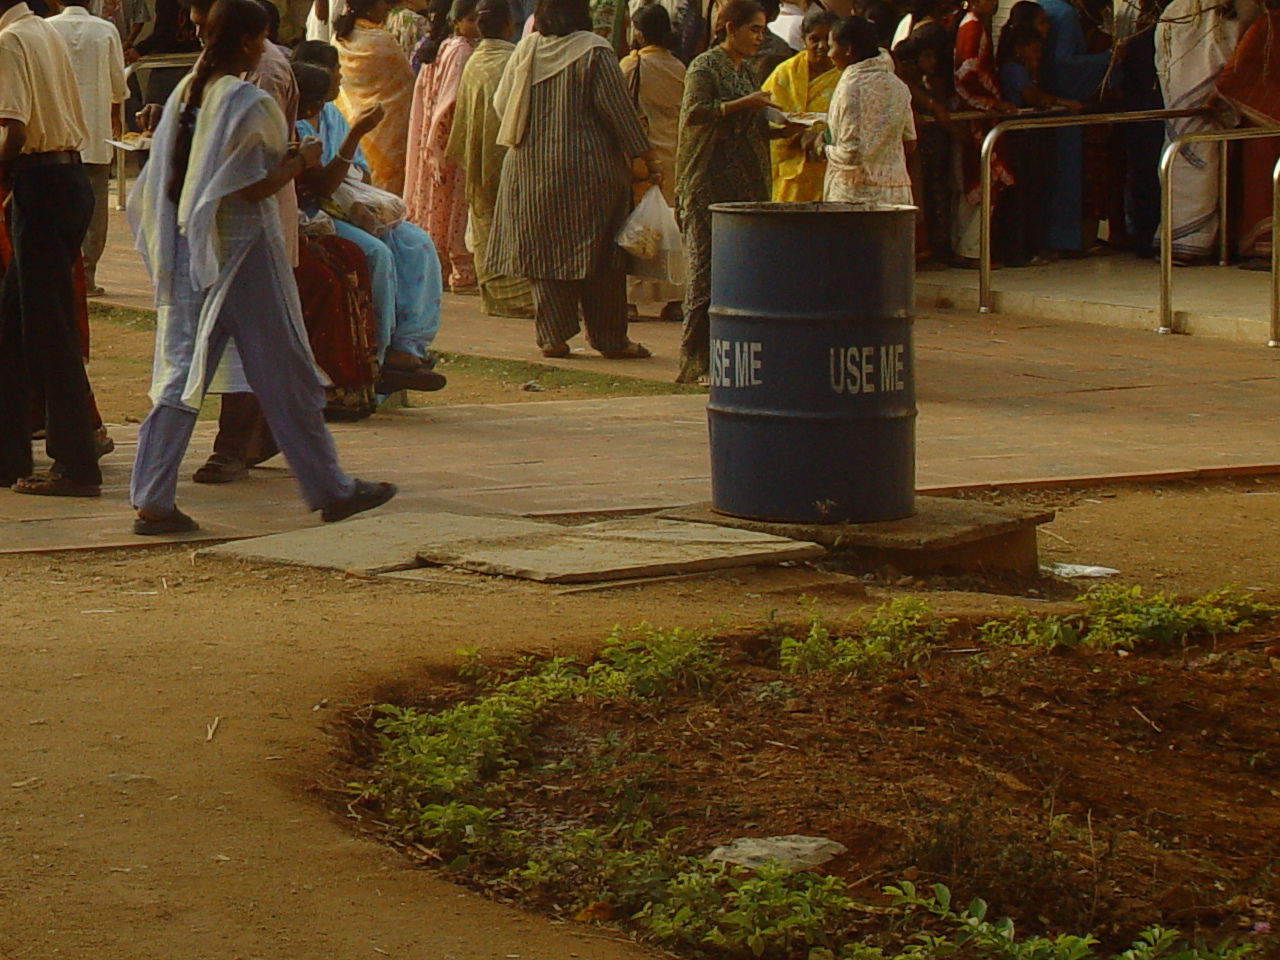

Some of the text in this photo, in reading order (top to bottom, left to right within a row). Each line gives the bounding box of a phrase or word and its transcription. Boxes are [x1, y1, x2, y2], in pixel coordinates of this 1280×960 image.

[735, 341, 763, 388] ME
[830, 344, 905, 394] USE ME
